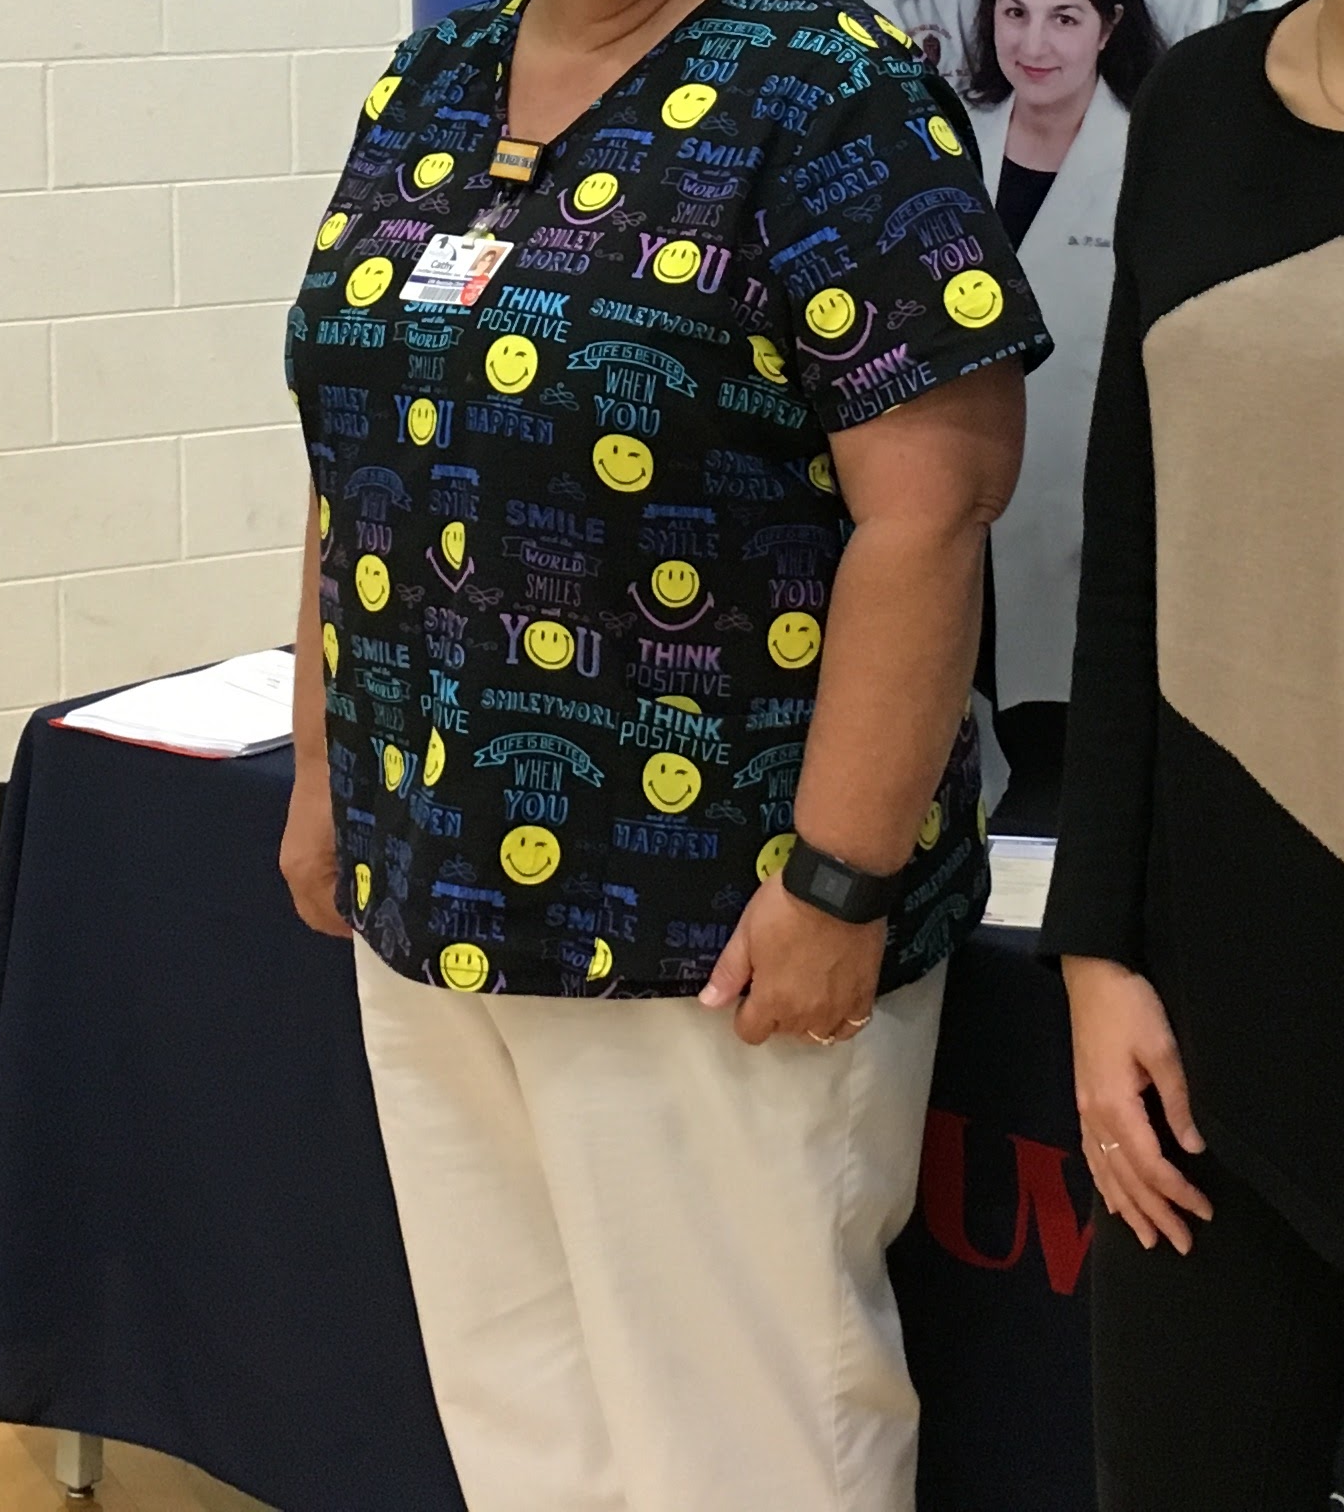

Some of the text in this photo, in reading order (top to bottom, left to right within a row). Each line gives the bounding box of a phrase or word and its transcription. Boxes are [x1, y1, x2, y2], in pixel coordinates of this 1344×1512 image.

[699, 37, 746, 61] WHEN
[680, 57, 739, 85] YOU
[793, 134, 877, 193] SMILEY
[682, 178, 734, 198] WORLD
[801, 160, 890, 217] WORLD
[370, 219, 435, 241] THINK
[671, 201, 724, 228] SMILES
[914, 209, 965, 249] WHEN
[529, 226, 605, 253] SMILEY
[516, 248, 591, 276] WORLD
[919, 234, 984, 282] YOU
[496, 285, 571, 319] THINK
[316, 320, 386, 349] HAPPEN
[408, 330, 449, 349] WORLD
[476, 307, 574, 344] POSITIVE
[408, 354, 446, 382] SMILES
[591, 345, 684, 380] LIFE IS BETTER
[831, 342, 917, 401] THINK
[606, 364, 657, 405] WHEN
[594, 394, 661, 438] YOU
[717, 382, 808, 429] HAPPEN
[465, 405, 554, 445] HAPPEN
[505, 498, 606, 544] SMILE
[524, 548, 582, 573] WORLD
[524, 573, 582, 607] SMILES
[768, 578, 825, 610] YOU
[638, 636, 723, 674] THINK
[625, 662, 733, 698] POSITIVE
[480, 687, 615, 731] SMILEYWORL
[637, 696, 724, 740] THINK
[497, 736, 590, 769] LIFE IS BETTER
[619, 720, 732, 765] POSITIVE
[514, 757, 564, 793] WHEN
[503, 788, 570, 826] YOU
[613, 823, 719, 860] HAPPEN
